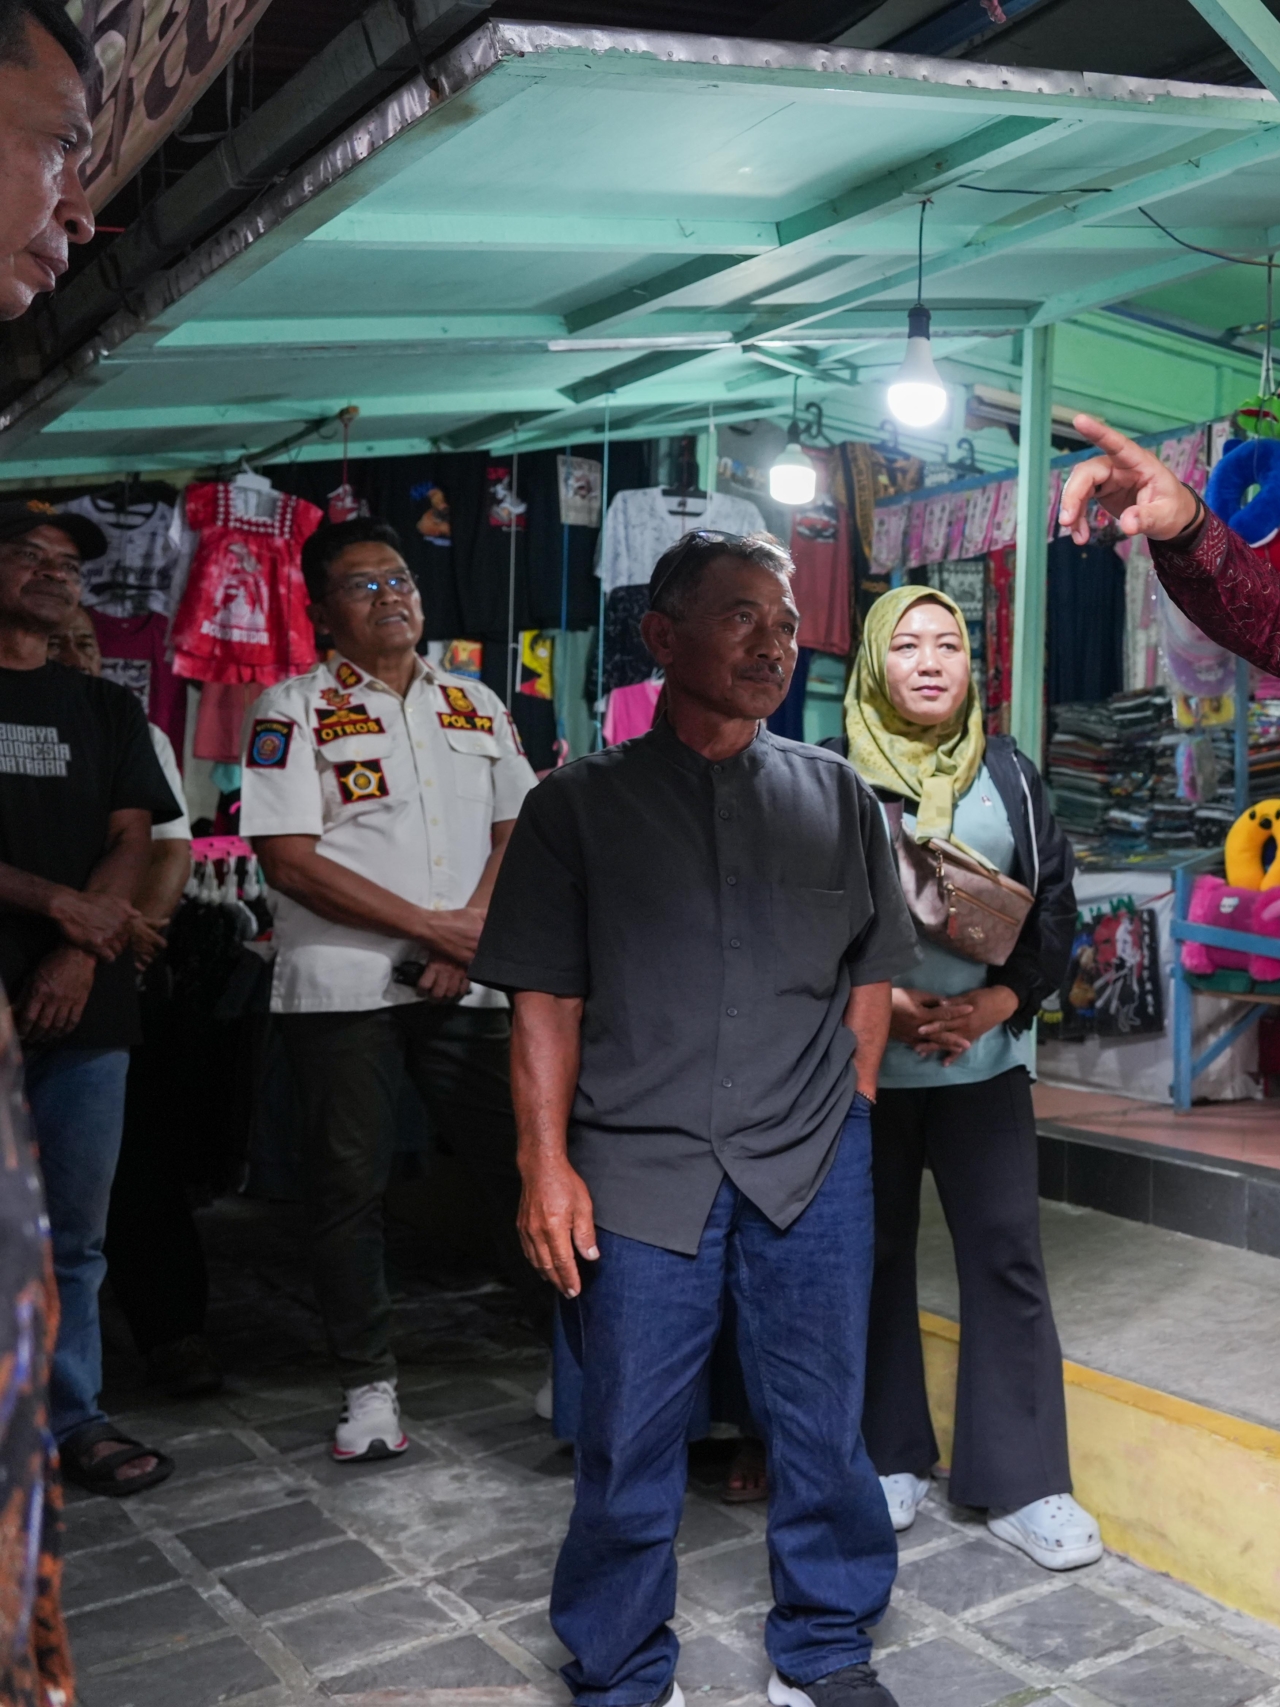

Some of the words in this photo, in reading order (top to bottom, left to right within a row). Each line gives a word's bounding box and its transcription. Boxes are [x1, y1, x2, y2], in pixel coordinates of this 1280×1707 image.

[321, 721, 379, 741] OTROS
[441, 714, 472, 728] POL
[474, 717, 492, 731] PP
